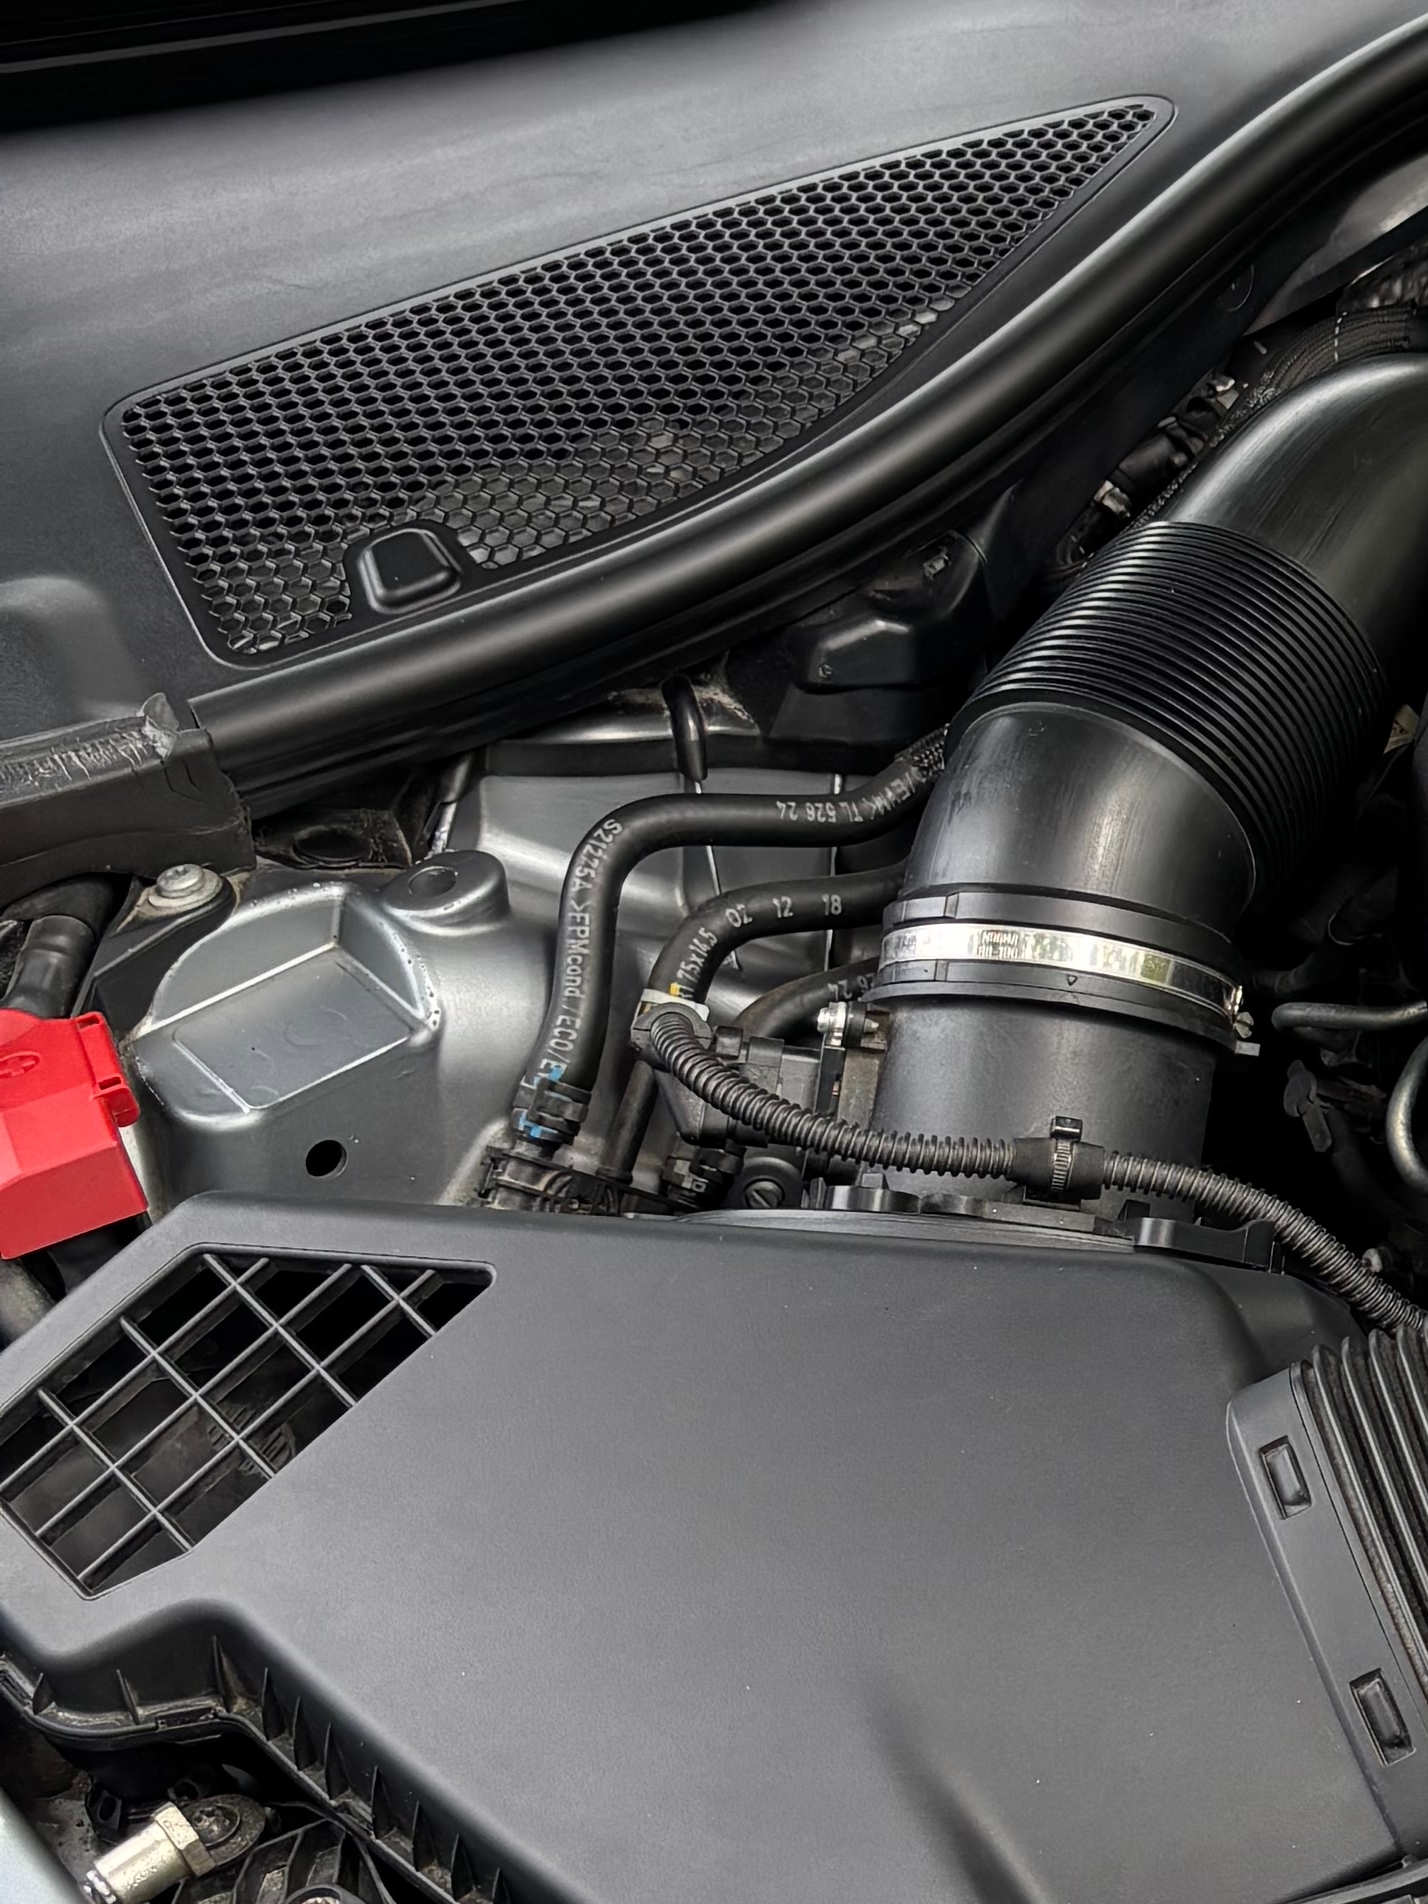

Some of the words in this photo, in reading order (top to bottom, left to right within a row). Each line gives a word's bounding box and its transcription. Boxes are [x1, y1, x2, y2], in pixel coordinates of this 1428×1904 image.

[724, 902, 754, 928] 02
[771, 896, 794, 919] 12
[821, 894, 843, 916] 18
